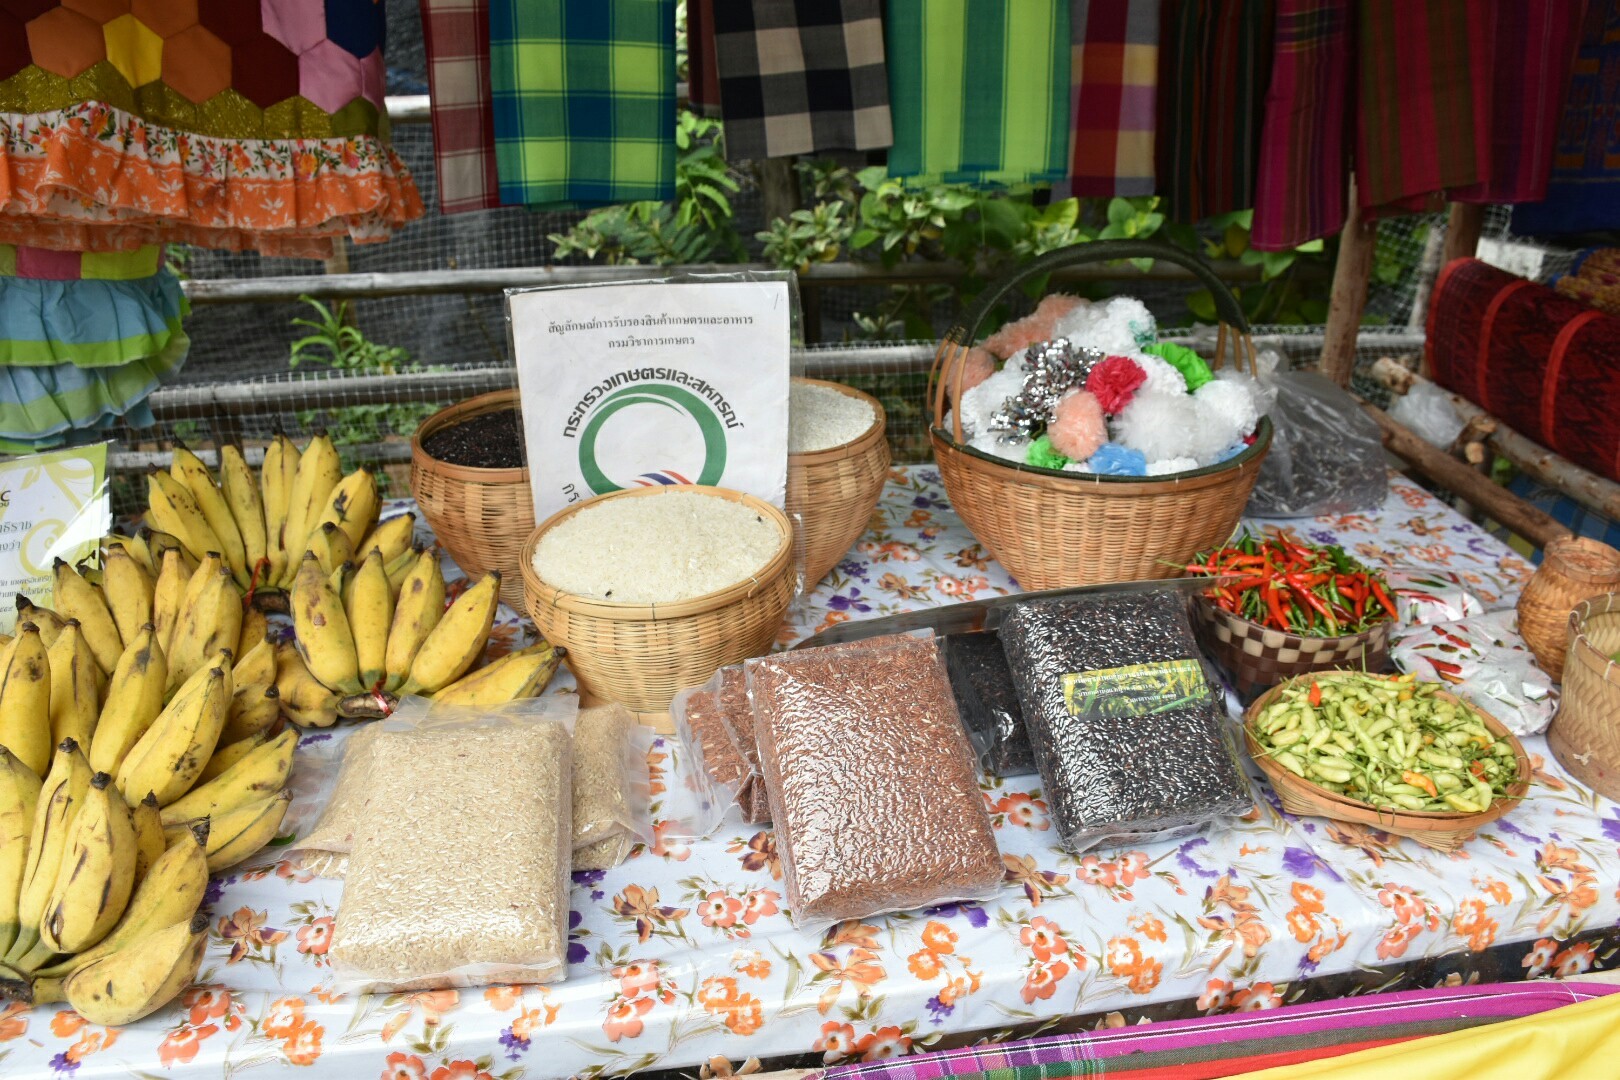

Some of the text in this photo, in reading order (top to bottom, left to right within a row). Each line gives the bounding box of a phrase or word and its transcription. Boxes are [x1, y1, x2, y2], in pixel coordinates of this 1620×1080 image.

[548, 313, 754, 335] สัญลักษณ์การรับรองสินค้าเกษตรและอาหาร
[608, 335, 695, 348] กรมวิชาการเกษตร
[563, 367, 745, 438] กระทรวงเกษตรและสหกรณ์
